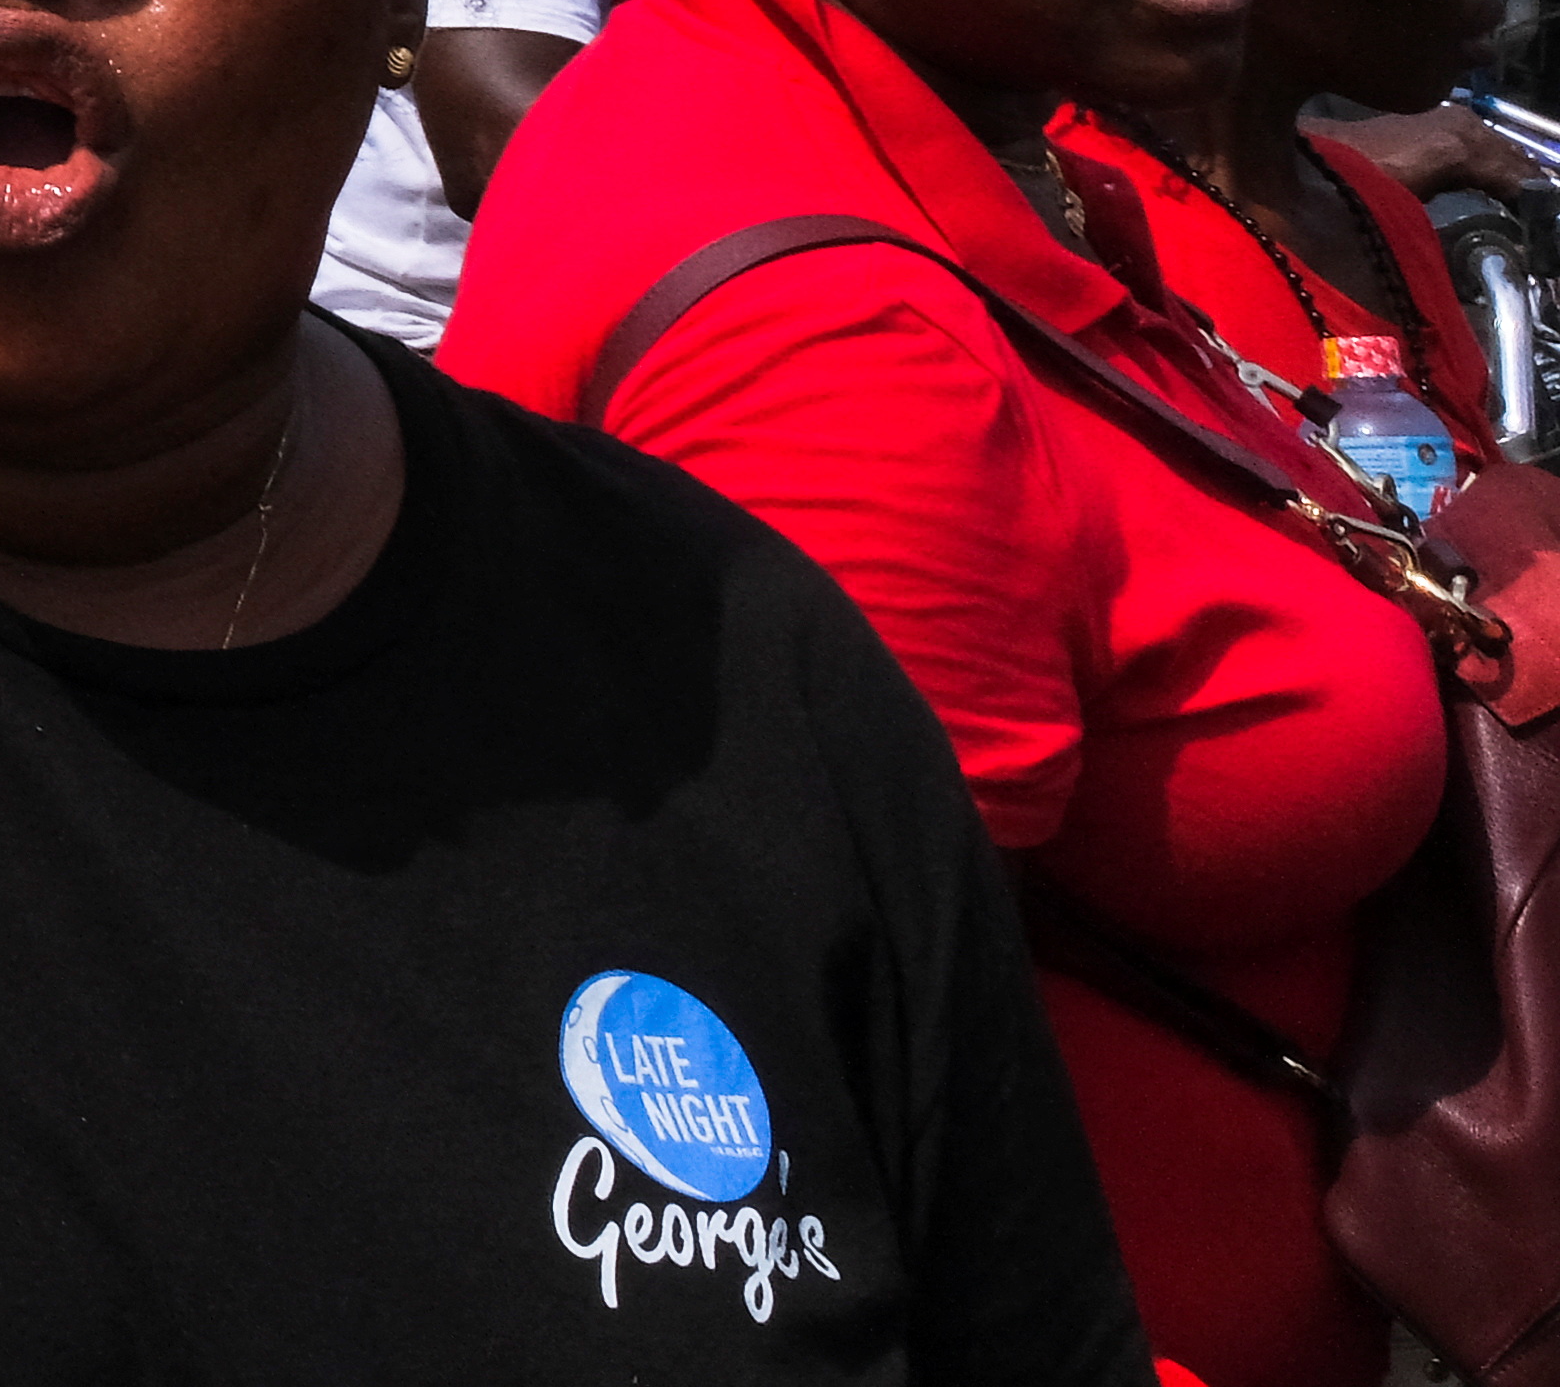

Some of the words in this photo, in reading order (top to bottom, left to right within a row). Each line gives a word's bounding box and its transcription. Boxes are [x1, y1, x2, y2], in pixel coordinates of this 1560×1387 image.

[605, 1032, 699, 1088] LATE
[641, 1092, 759, 1145] NIGHT
[552, 1135, 841, 1323] George's
